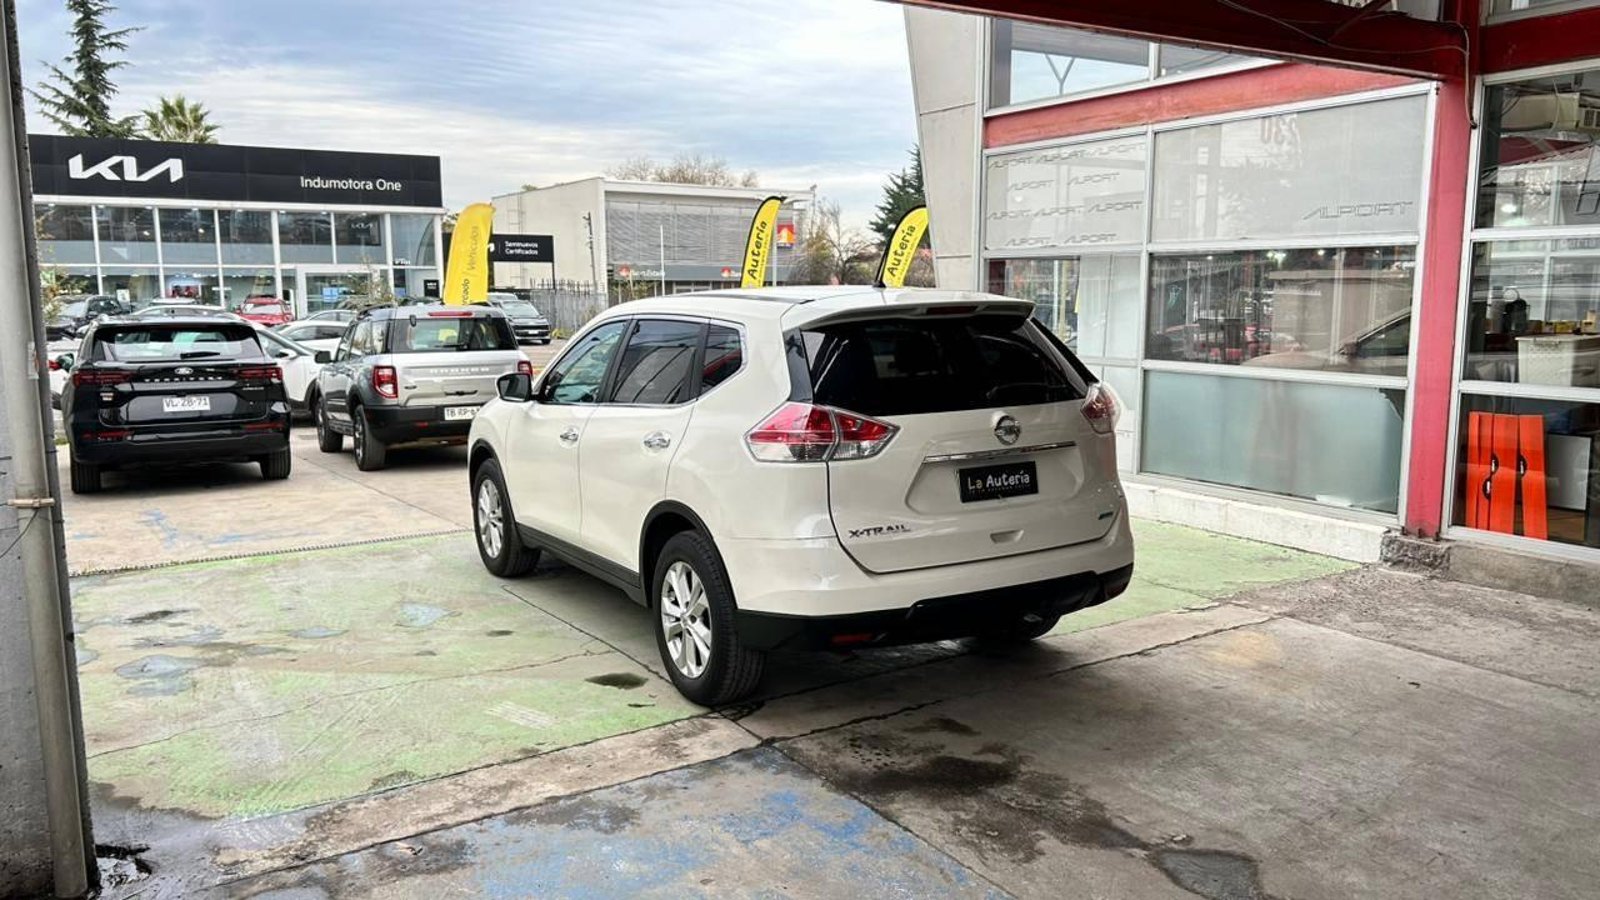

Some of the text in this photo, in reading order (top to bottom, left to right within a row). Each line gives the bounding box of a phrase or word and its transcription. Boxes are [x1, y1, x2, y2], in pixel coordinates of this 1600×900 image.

[68, 153, 183, 183] KIA
[300, 175, 402, 191] Indumotora One
[968, 477, 983, 490] La
[986, 470, 1030, 488] Autería
[849, 524, 911, 538] X-TRAIL
